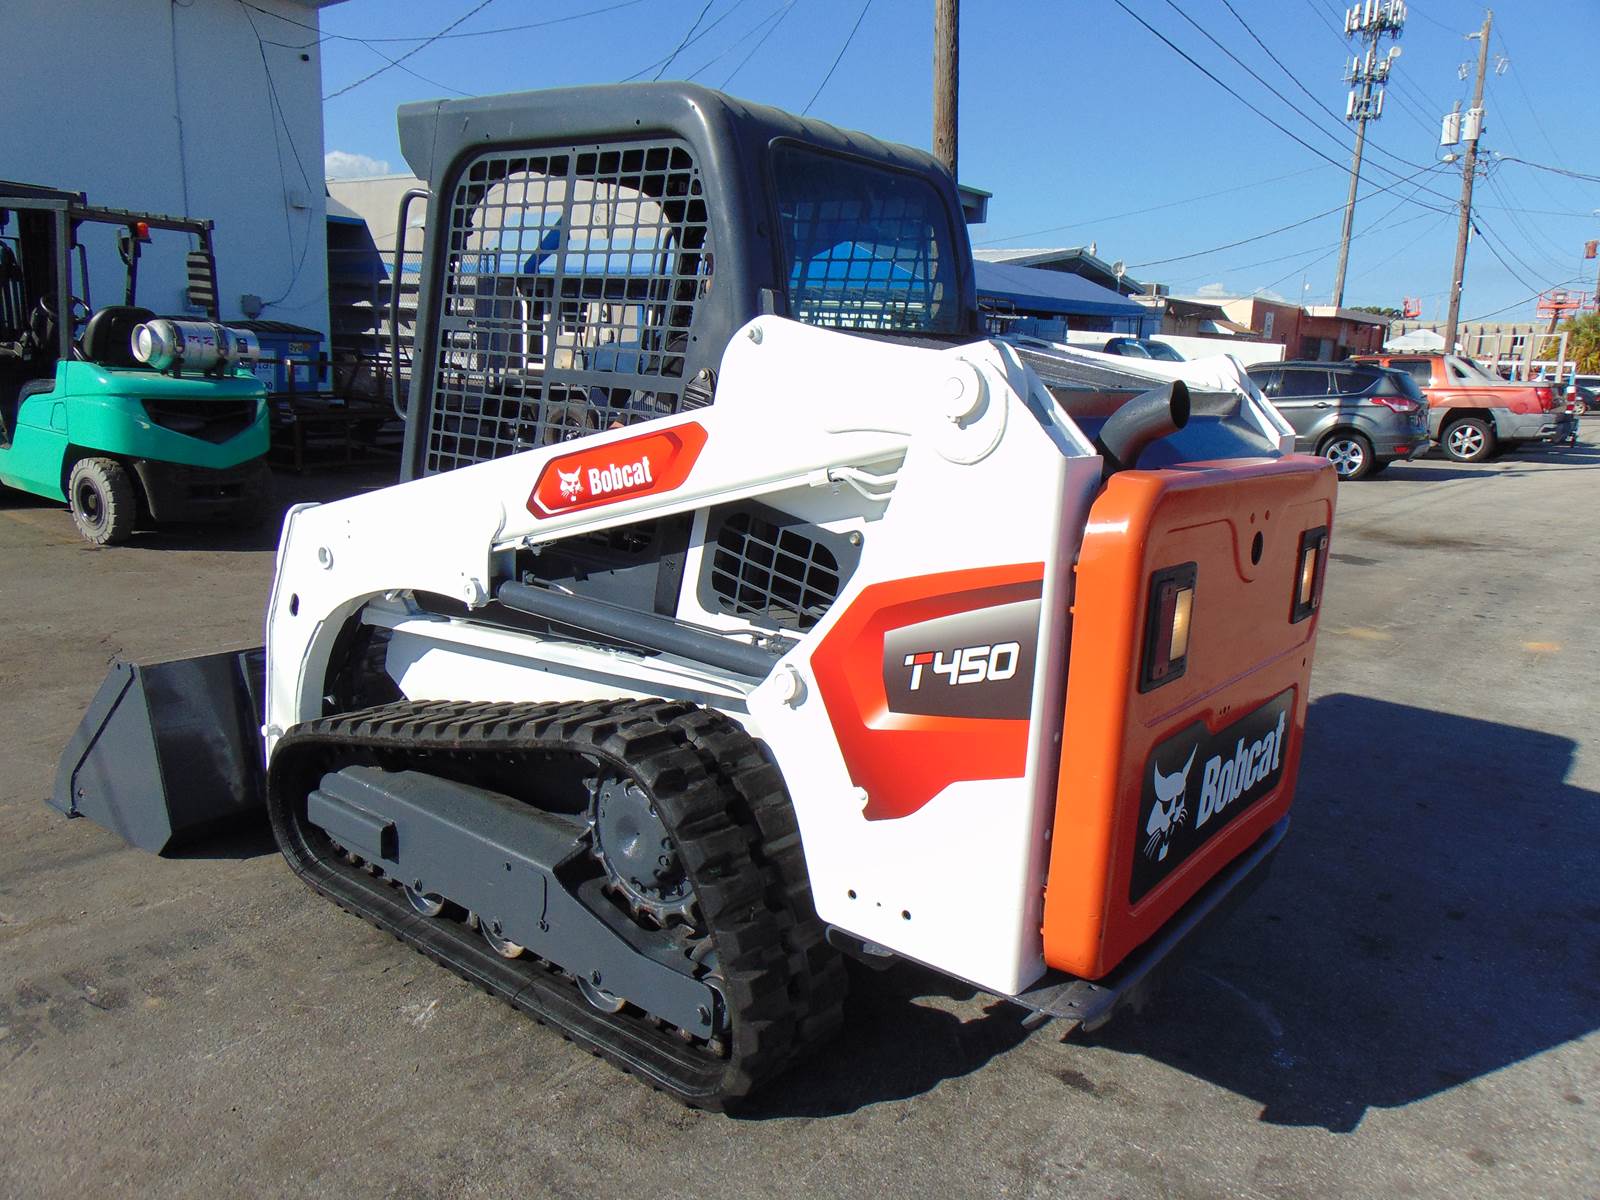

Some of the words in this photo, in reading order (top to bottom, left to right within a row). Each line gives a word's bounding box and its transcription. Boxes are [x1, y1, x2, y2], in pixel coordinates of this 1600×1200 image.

[588, 456, 652, 495] Bobcat
[904, 641, 1020, 690] T450
[1195, 710, 1286, 830] Bobcat
